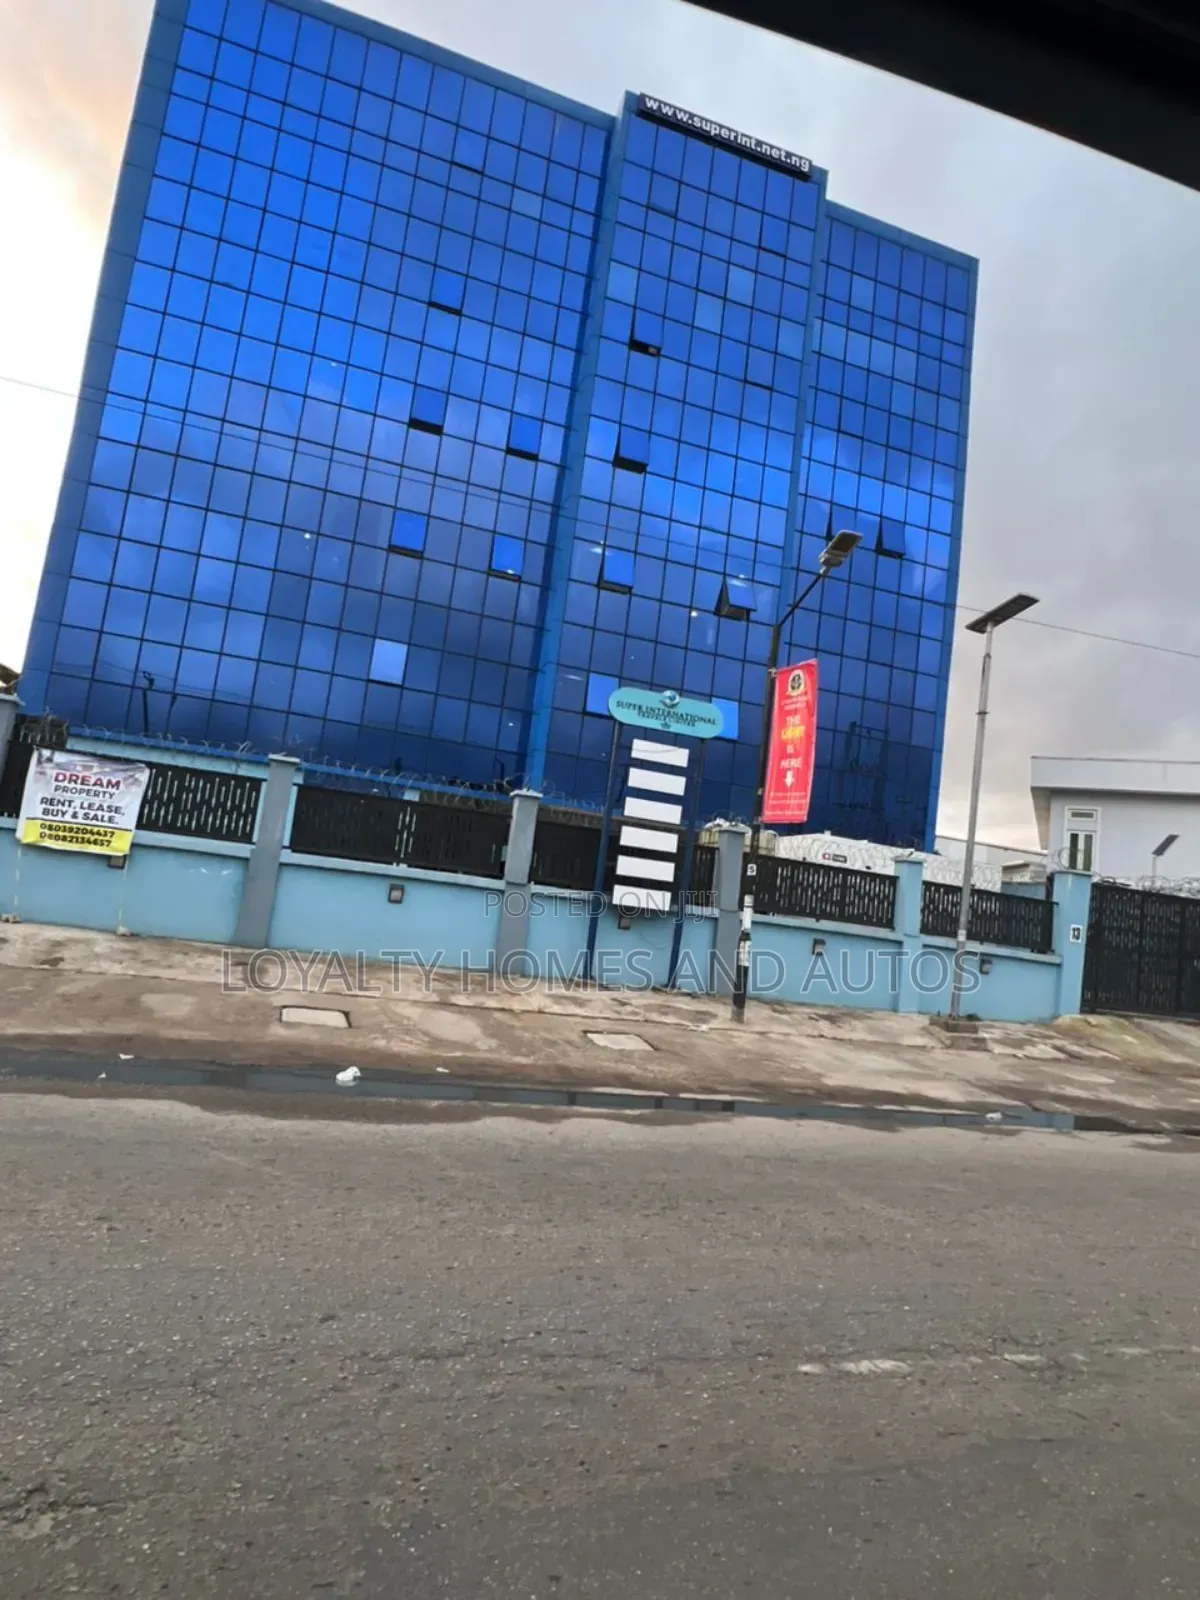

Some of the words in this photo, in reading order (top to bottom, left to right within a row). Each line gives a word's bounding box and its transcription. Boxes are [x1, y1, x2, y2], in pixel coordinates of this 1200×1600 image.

[645, 96, 810, 172] www.superint.net.ng
[616, 700, 646, 713] SUPER
[54, 771, 122, 791] DREAM
[54, 784, 116, 800] PROPERTY
[42, 807, 68, 818] BUY
[71, 810, 79, 820] &
[1072, 927, 1081, 941] 13
